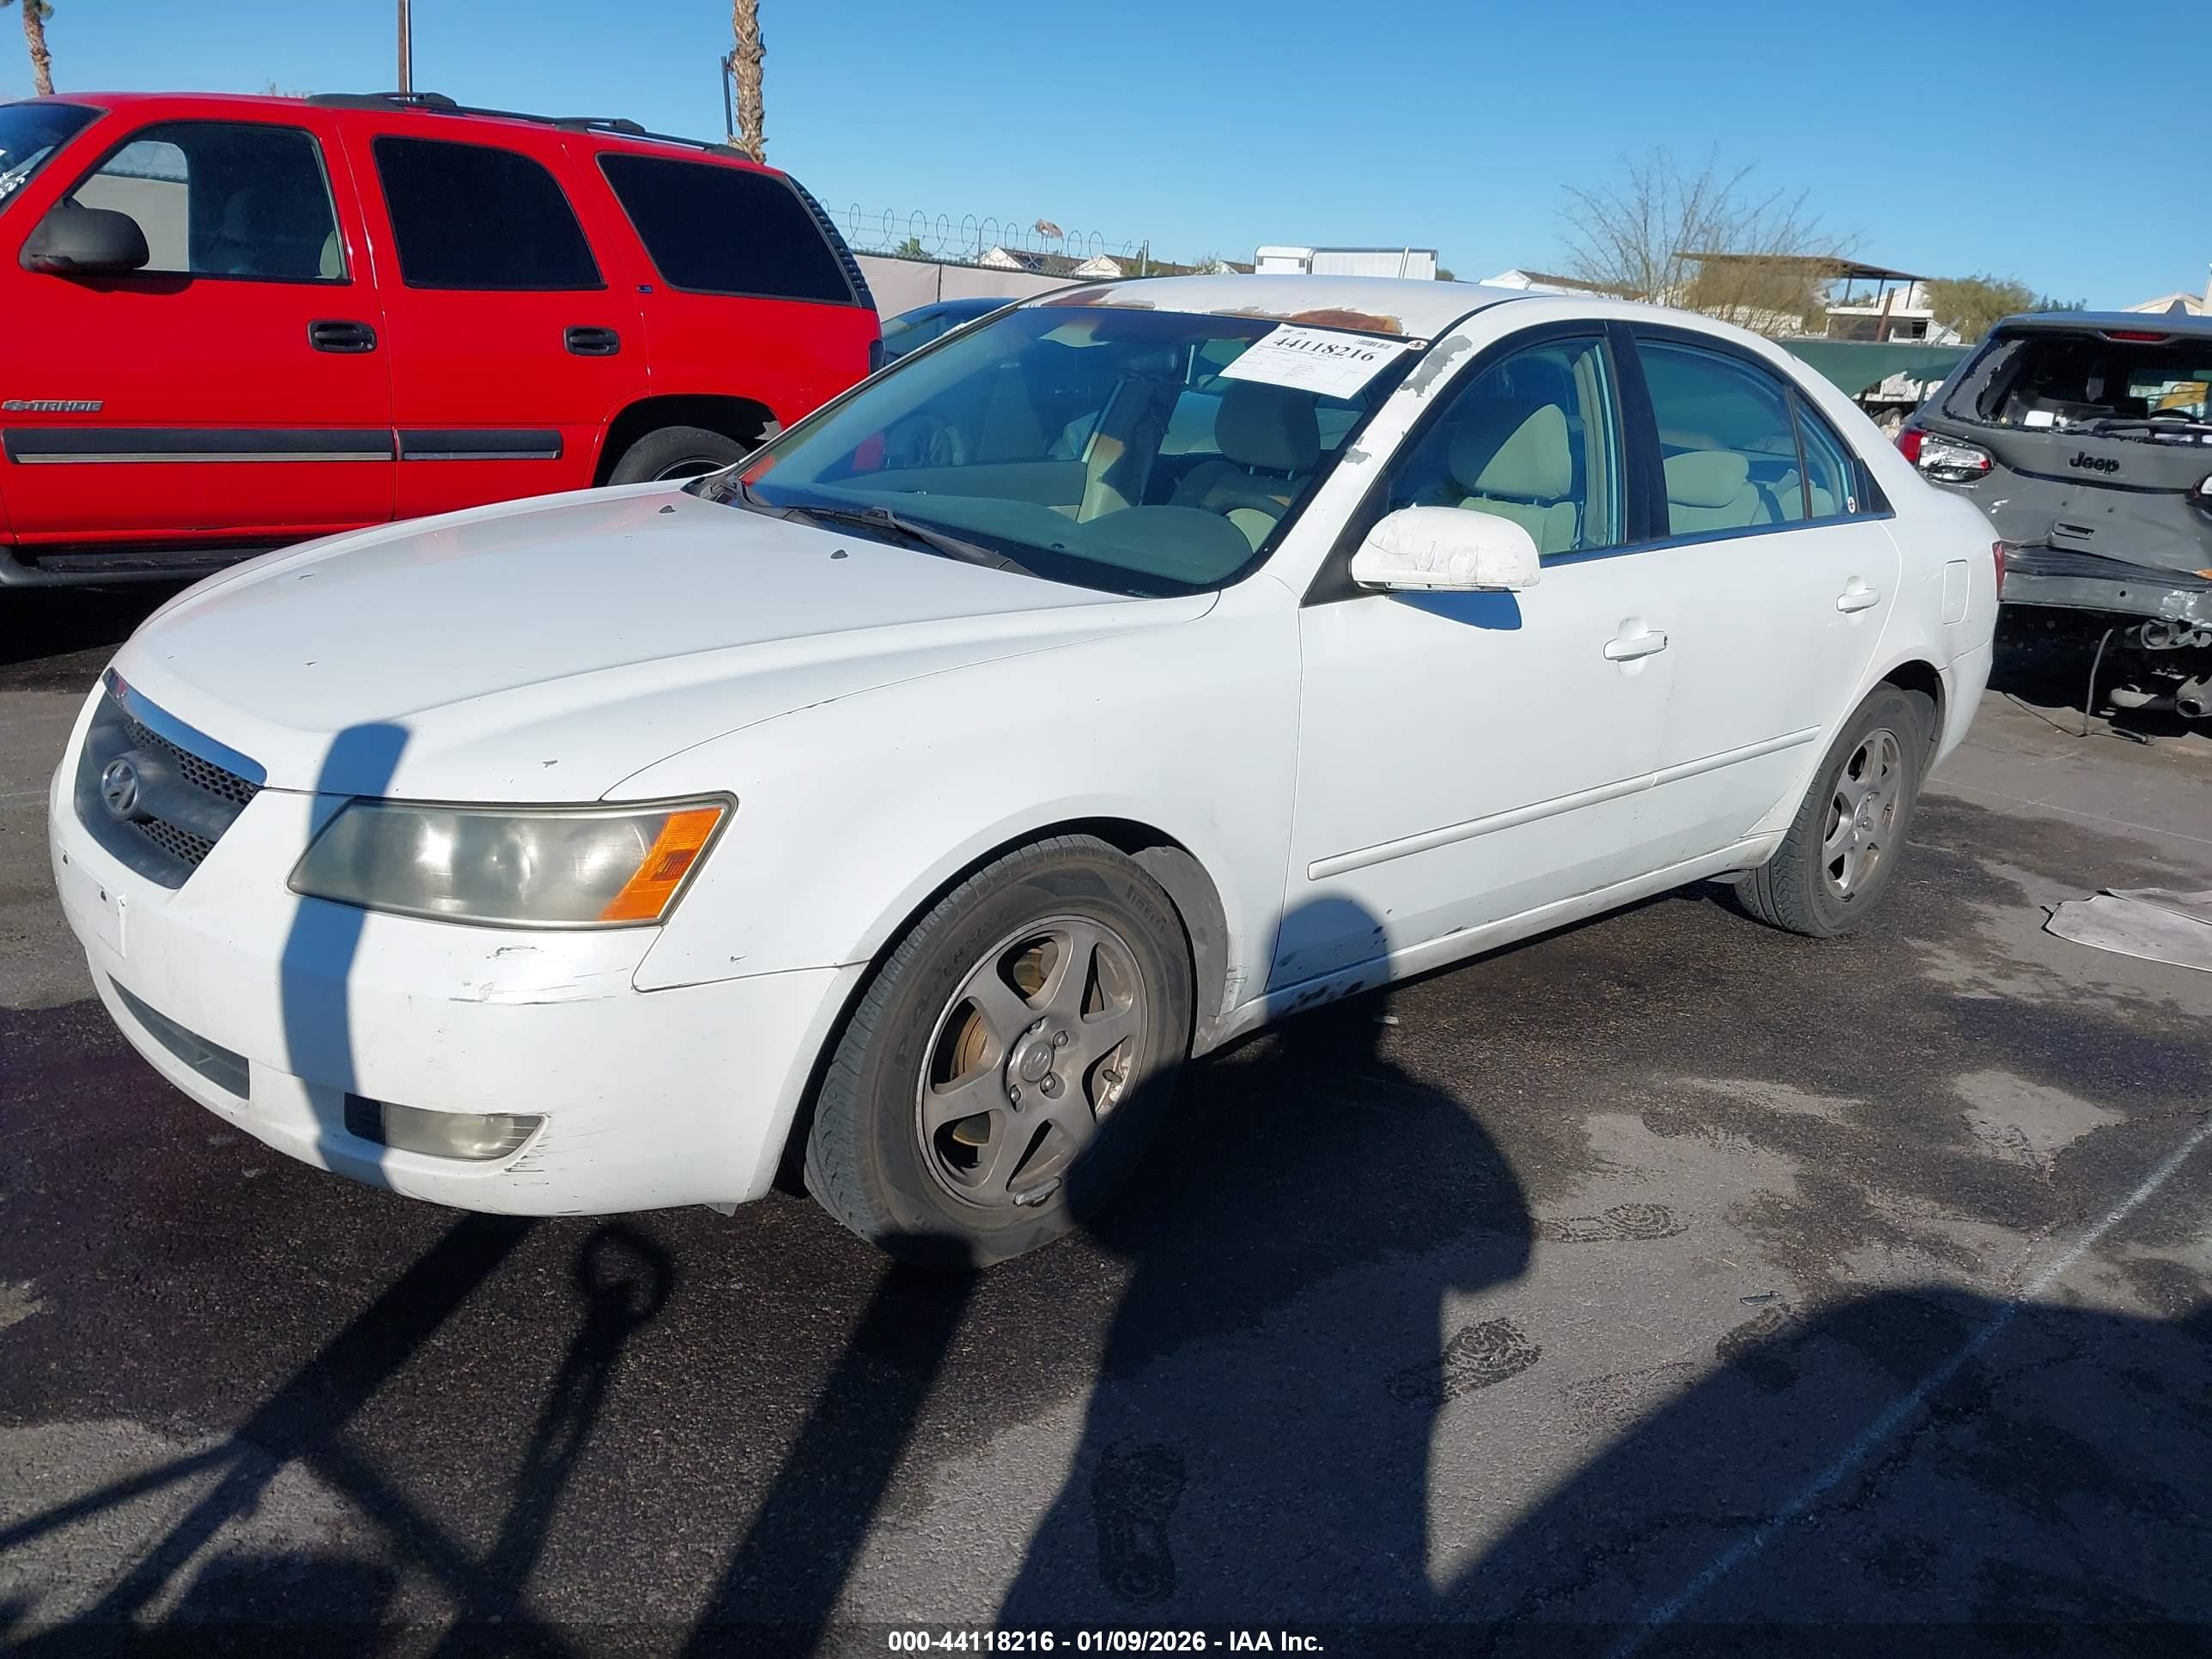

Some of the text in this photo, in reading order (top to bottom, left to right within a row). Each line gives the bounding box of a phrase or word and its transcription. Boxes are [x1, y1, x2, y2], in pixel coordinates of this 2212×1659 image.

[1273, 337, 1378, 362] 44118216
[33, 400, 103, 412] TAHOE
[2069, 452, 2120, 475] Jeep
